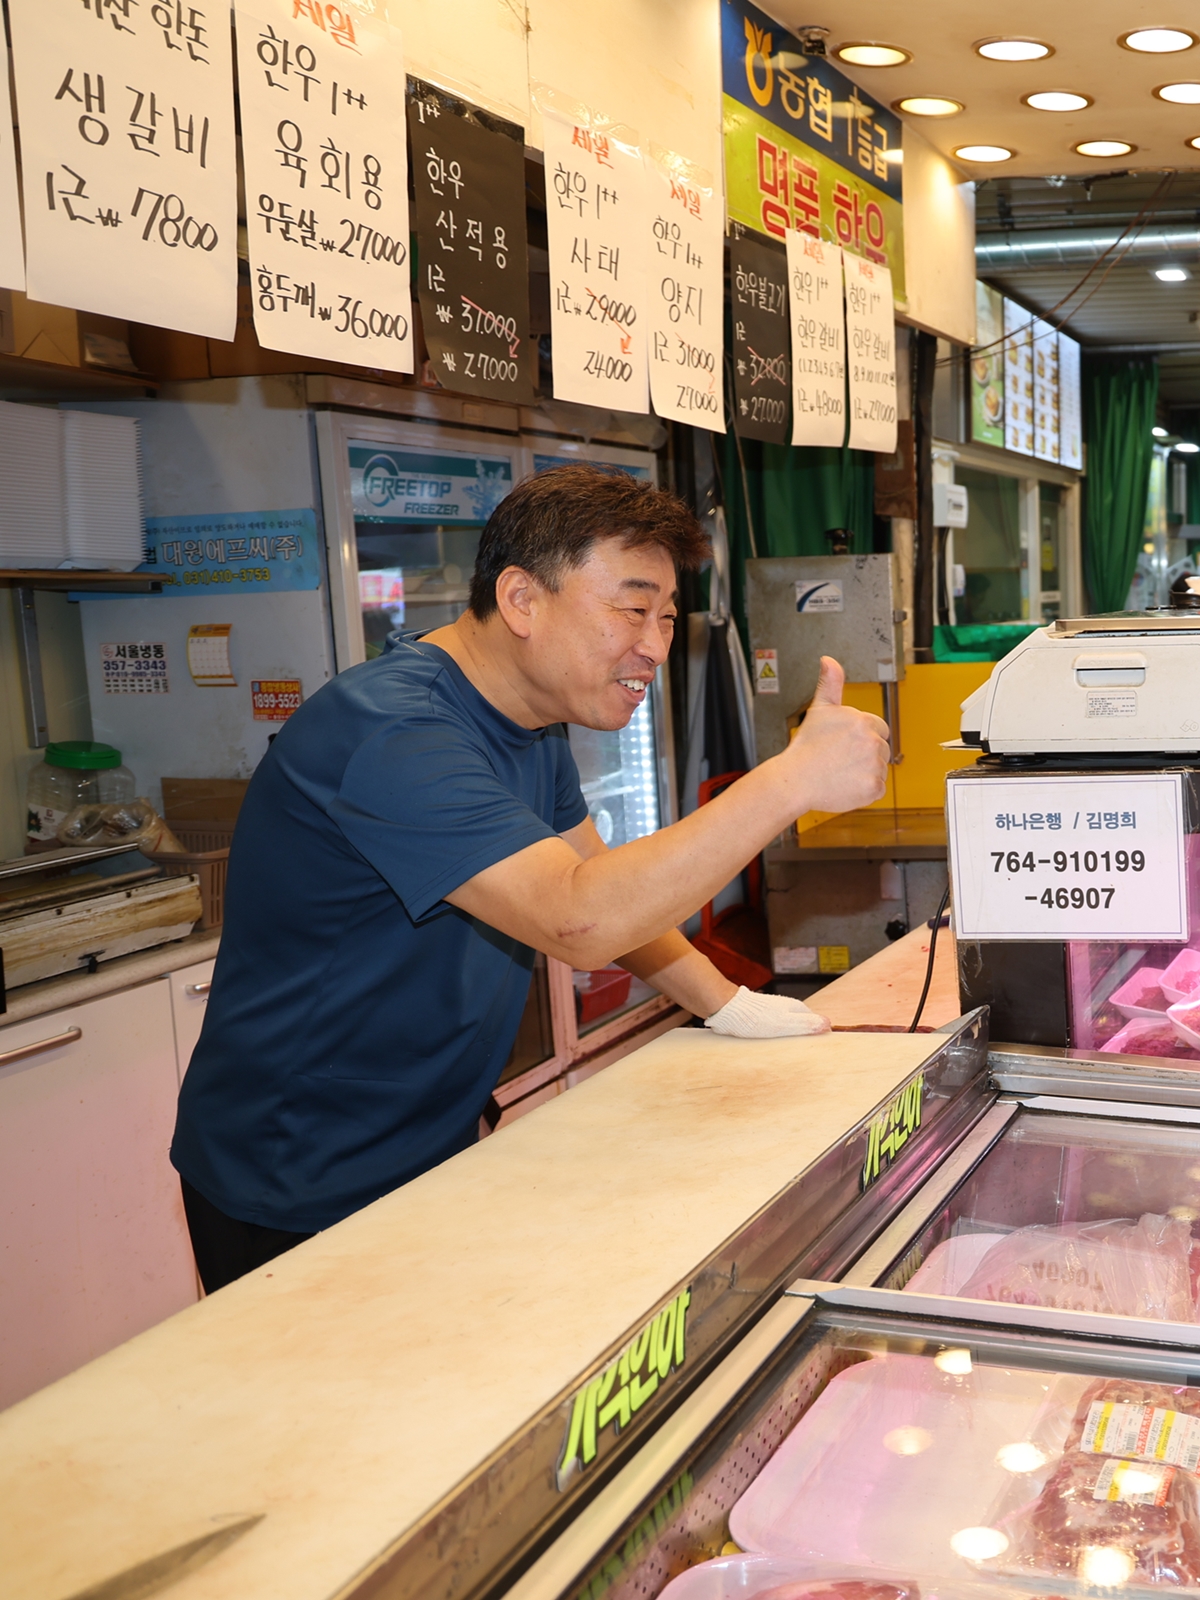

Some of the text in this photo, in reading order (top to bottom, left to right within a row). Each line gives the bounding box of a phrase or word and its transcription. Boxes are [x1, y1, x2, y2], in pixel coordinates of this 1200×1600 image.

[257, 24, 321, 101] 한우
[778, 52, 832, 142] 농협
[55, 68, 209, 168] 생갈비
[275, 119, 383, 210] 육회용
[426, 147, 464, 199] 한우
[554, 161, 587, 217] 한우
[756, 132, 820, 240] 명품
[436, 210, 508, 269] 산적용
[653, 215, 681, 260] 한우
[571, 237, 619, 281] 사태
[661, 277, 703, 326] 양지
[793, 266, 812, 304] 한우
[849, 282, 867, 316] 한우
[369, 476, 452, 502] FREETOP
[404, 502, 458, 515] FREEZER
[162, 534, 303, 565] 대원에프씨(주)
[183, 568, 271, 585] 031)410-3753
[103, 660, 166, 671] 357-3343
[115, 644, 165, 659] 서울냉동
[253, 693, 300, 708] 1899-5523
[995, 811, 1062, 831] 하나은행
[1086, 811, 1137, 830] 김명희
[990, 850, 1146, 873] 764-910199
[1024, 887, 1116, 909] -46907
